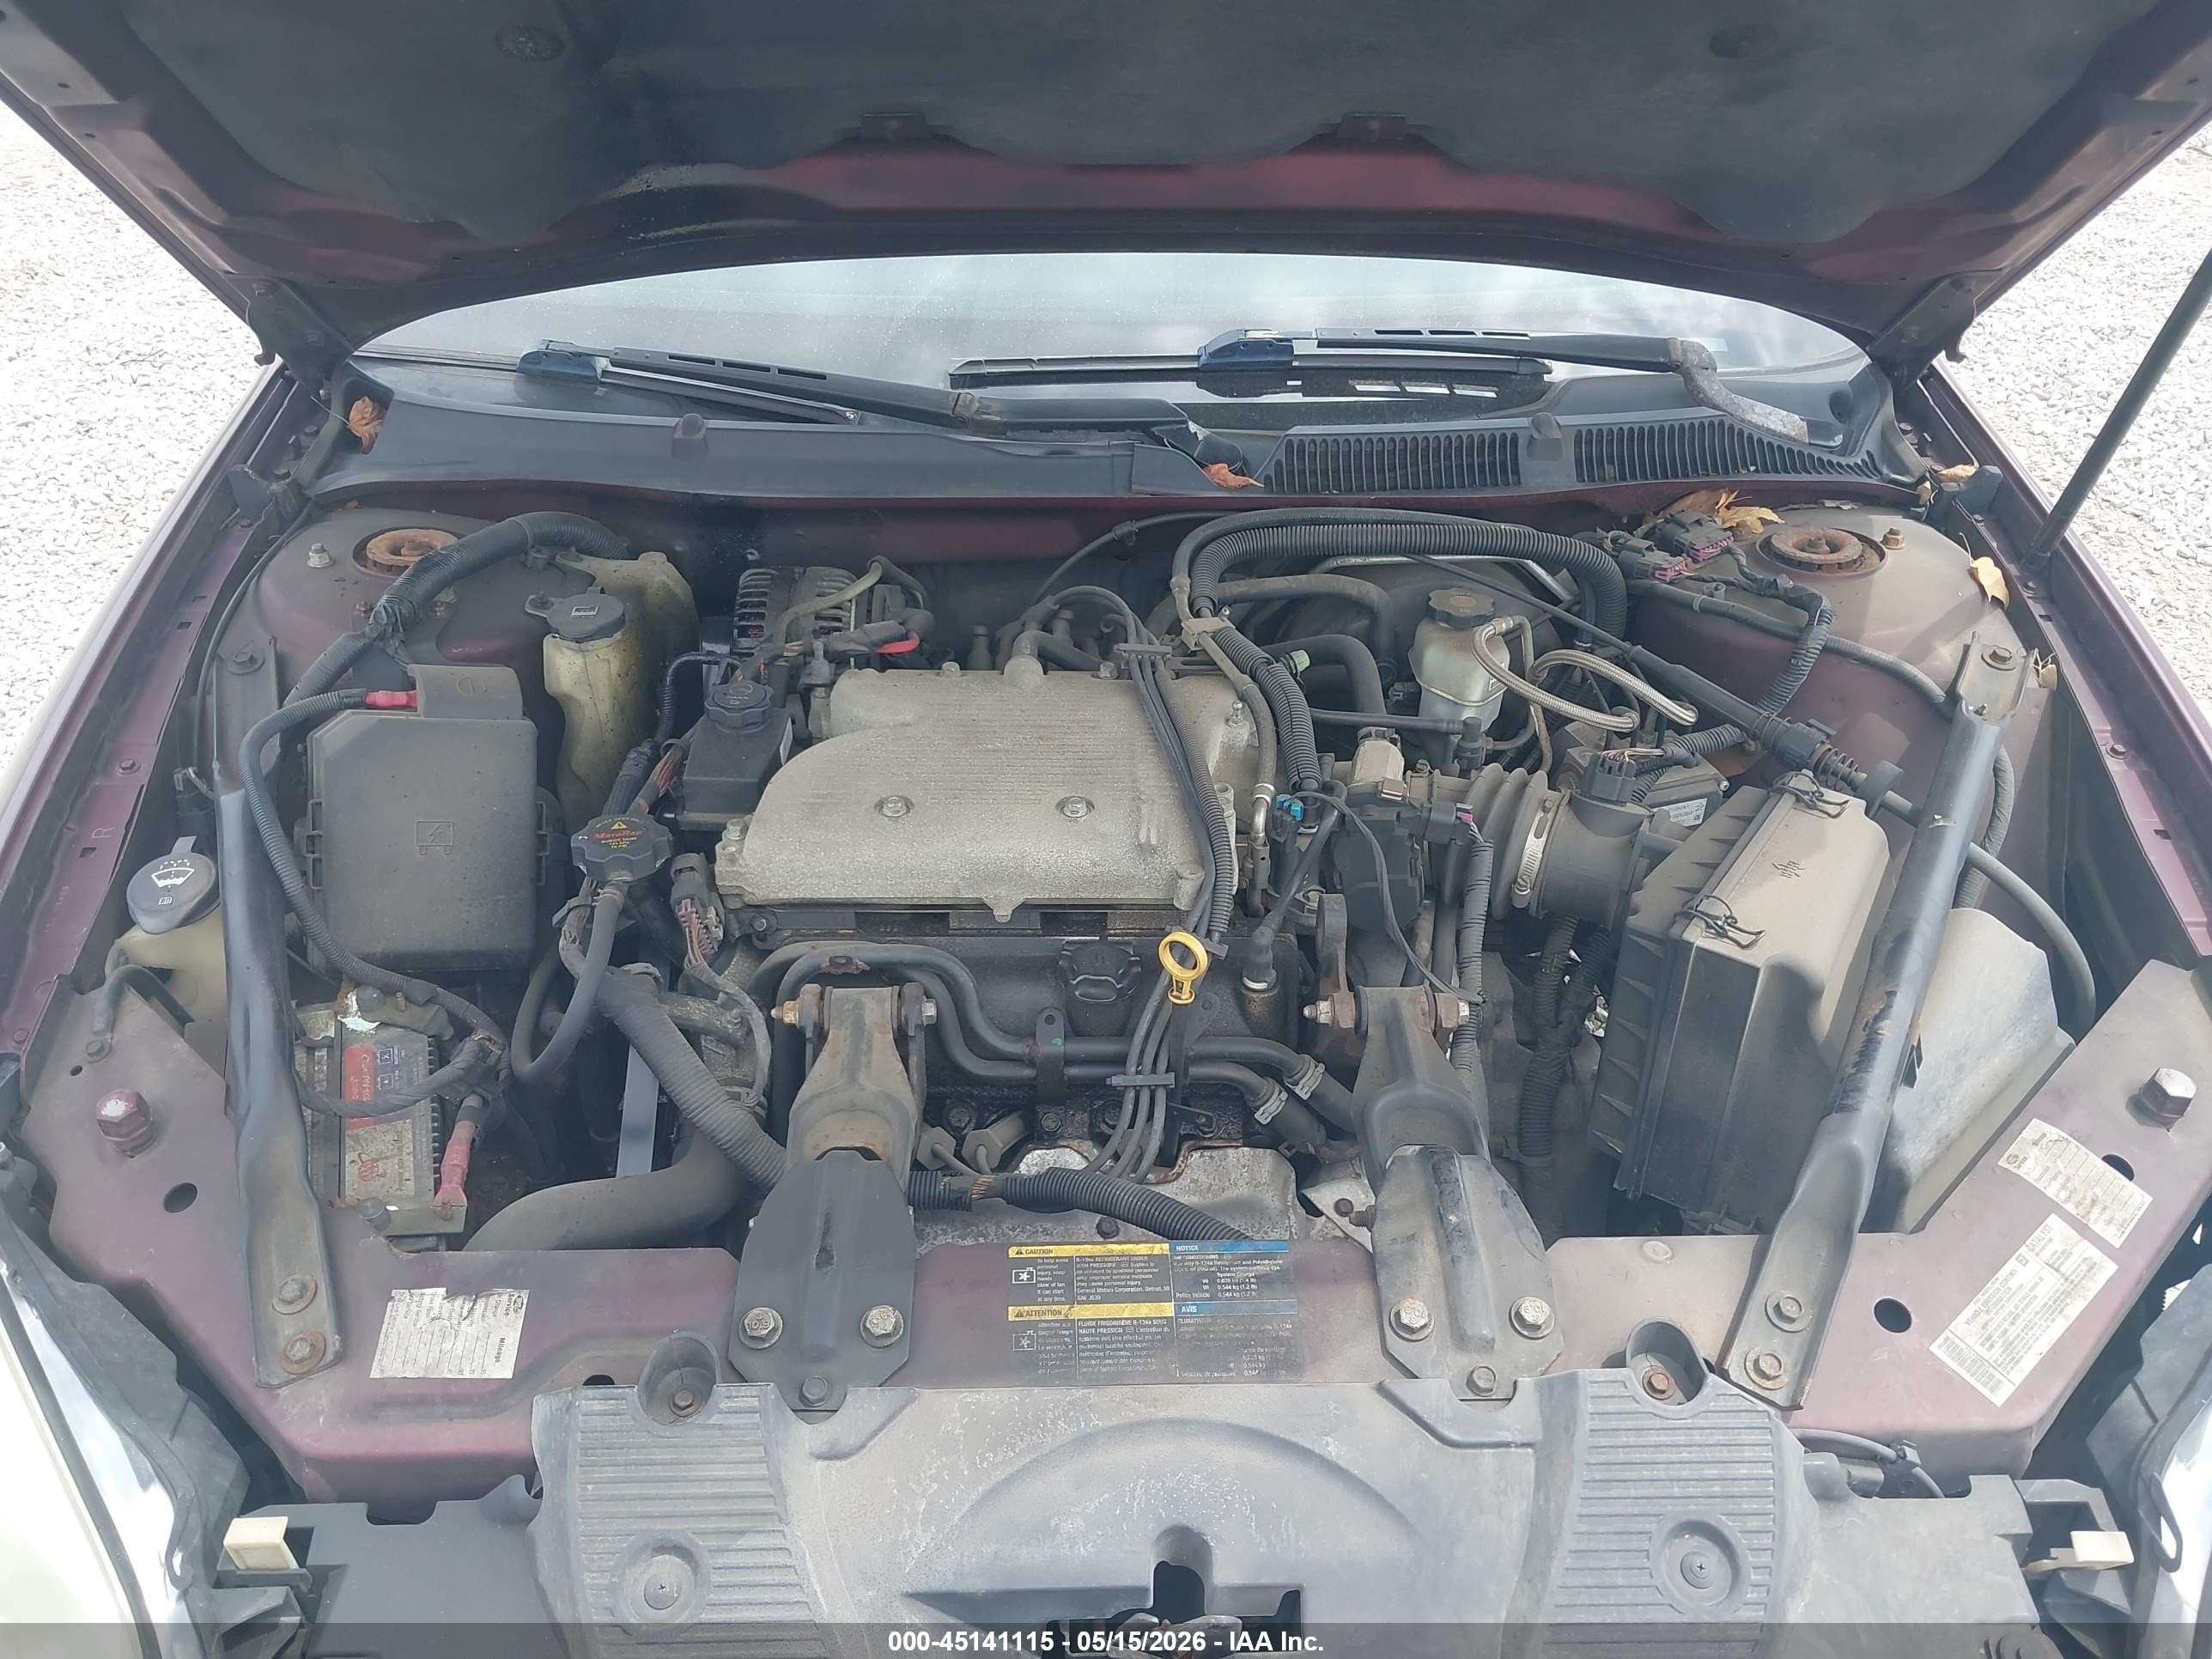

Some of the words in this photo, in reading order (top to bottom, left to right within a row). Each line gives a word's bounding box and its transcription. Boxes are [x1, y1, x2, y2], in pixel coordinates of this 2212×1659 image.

[2024, 1223, 2054, 1253] CATALYST
[504, 1293, 514, 1316] Service
[495, 1338, 506, 1364] Mileage
